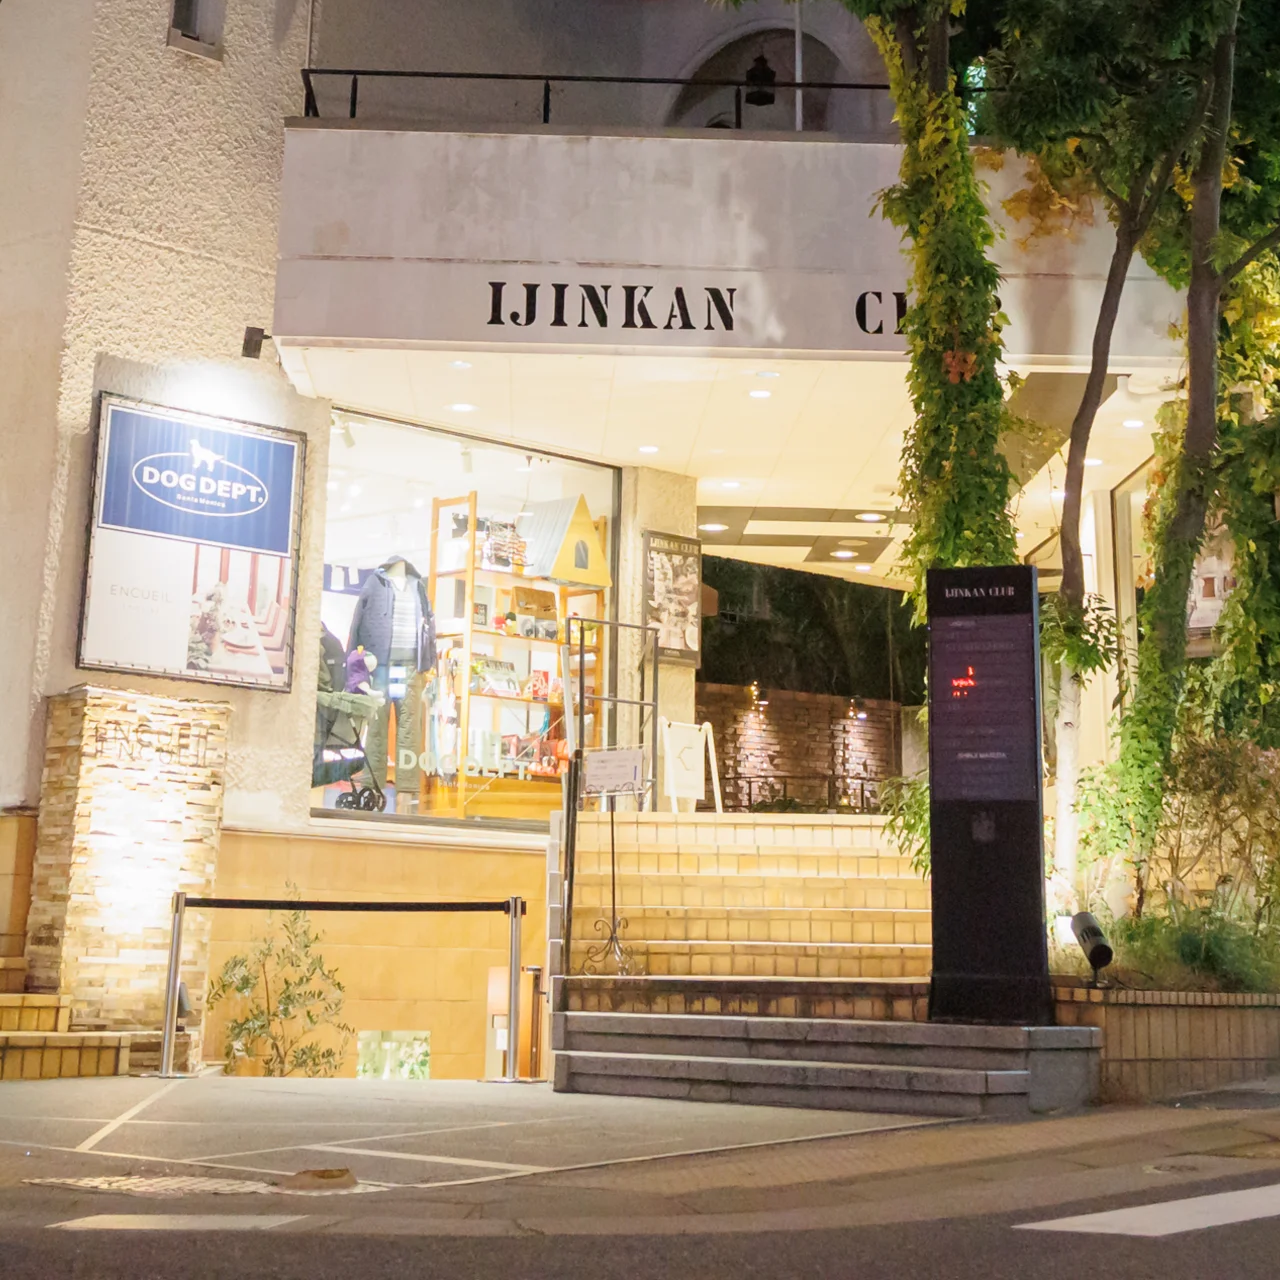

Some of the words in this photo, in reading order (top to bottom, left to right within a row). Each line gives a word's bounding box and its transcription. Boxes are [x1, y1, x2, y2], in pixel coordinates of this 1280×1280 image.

[487, 281, 737, 331] IJINKAN
[143, 466, 196, 491] DOG
[110, 584, 173, 603] ENCUEIL
